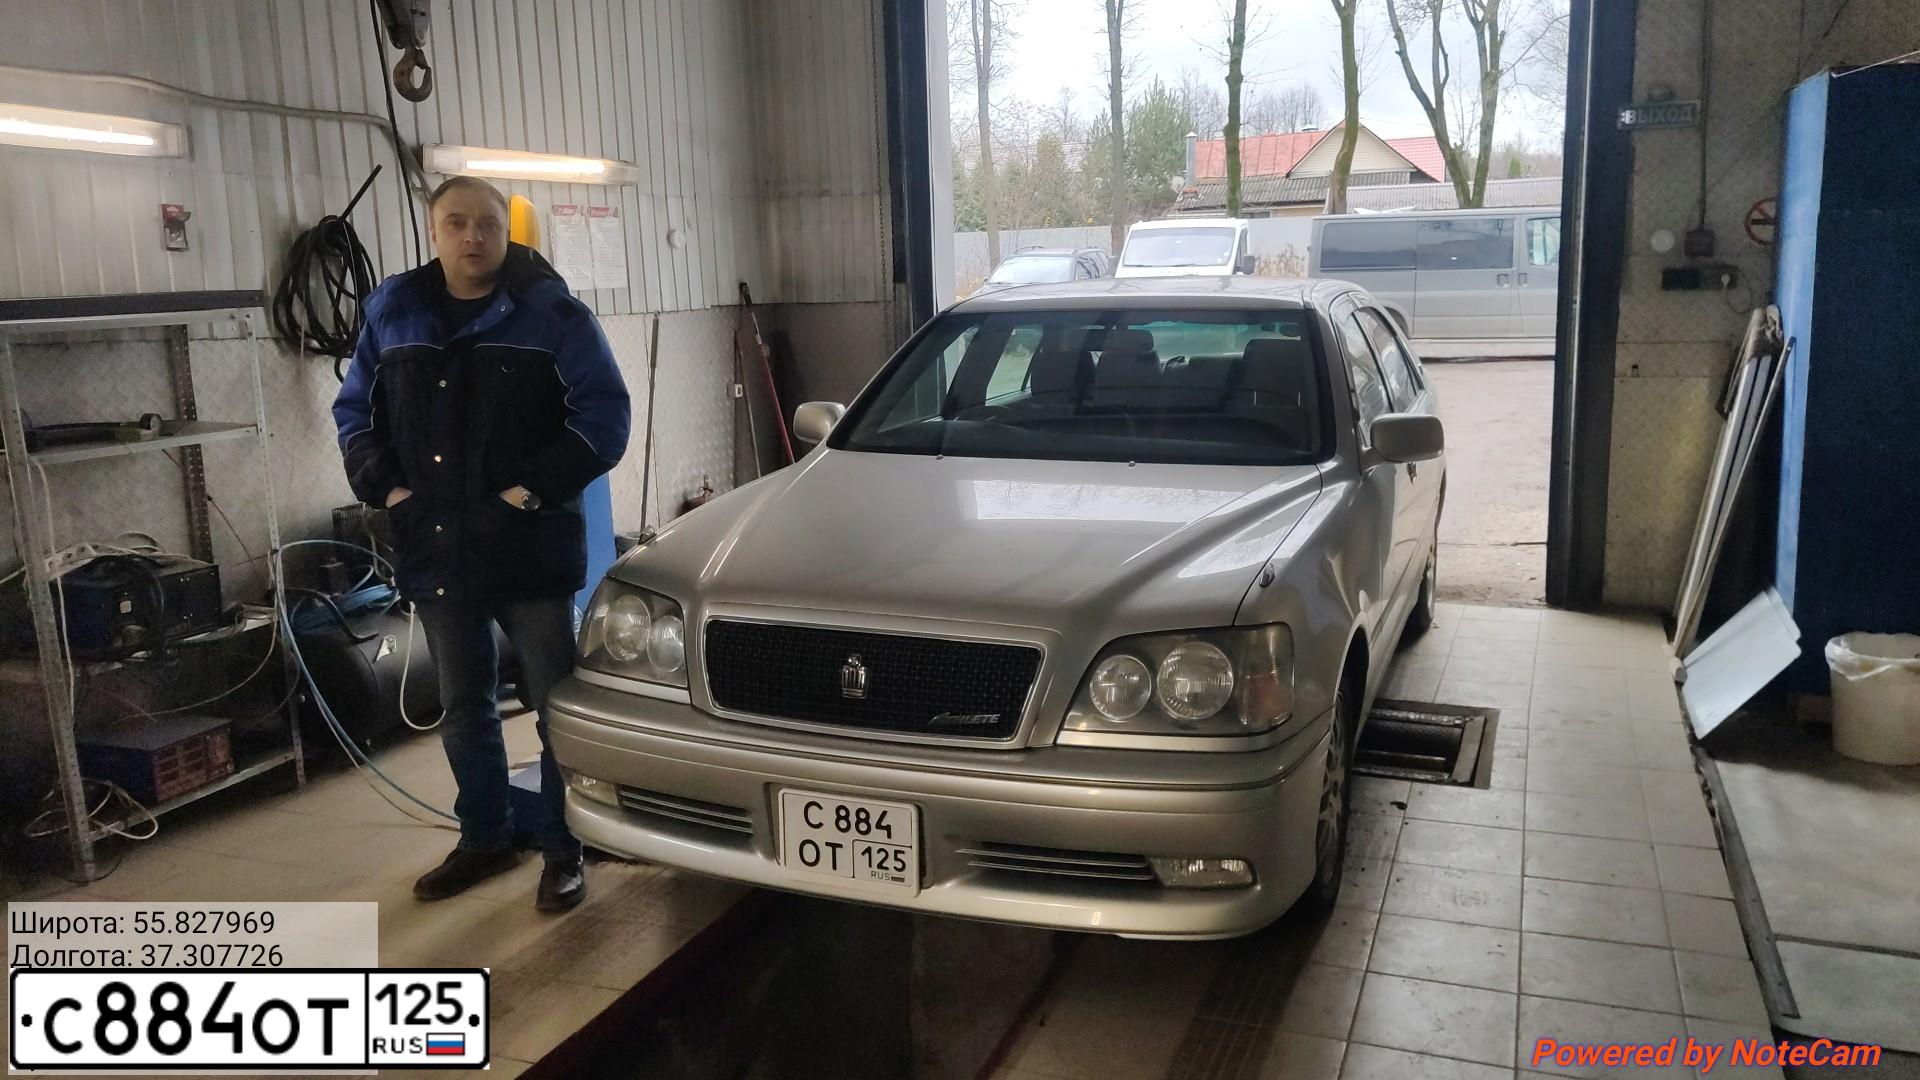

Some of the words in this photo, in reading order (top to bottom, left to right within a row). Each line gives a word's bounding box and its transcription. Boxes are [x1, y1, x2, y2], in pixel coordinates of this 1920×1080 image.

[834, 804, 892, 839] 884
[860, 845, 906, 873] 125
[870, 870, 891, 881] RUS
